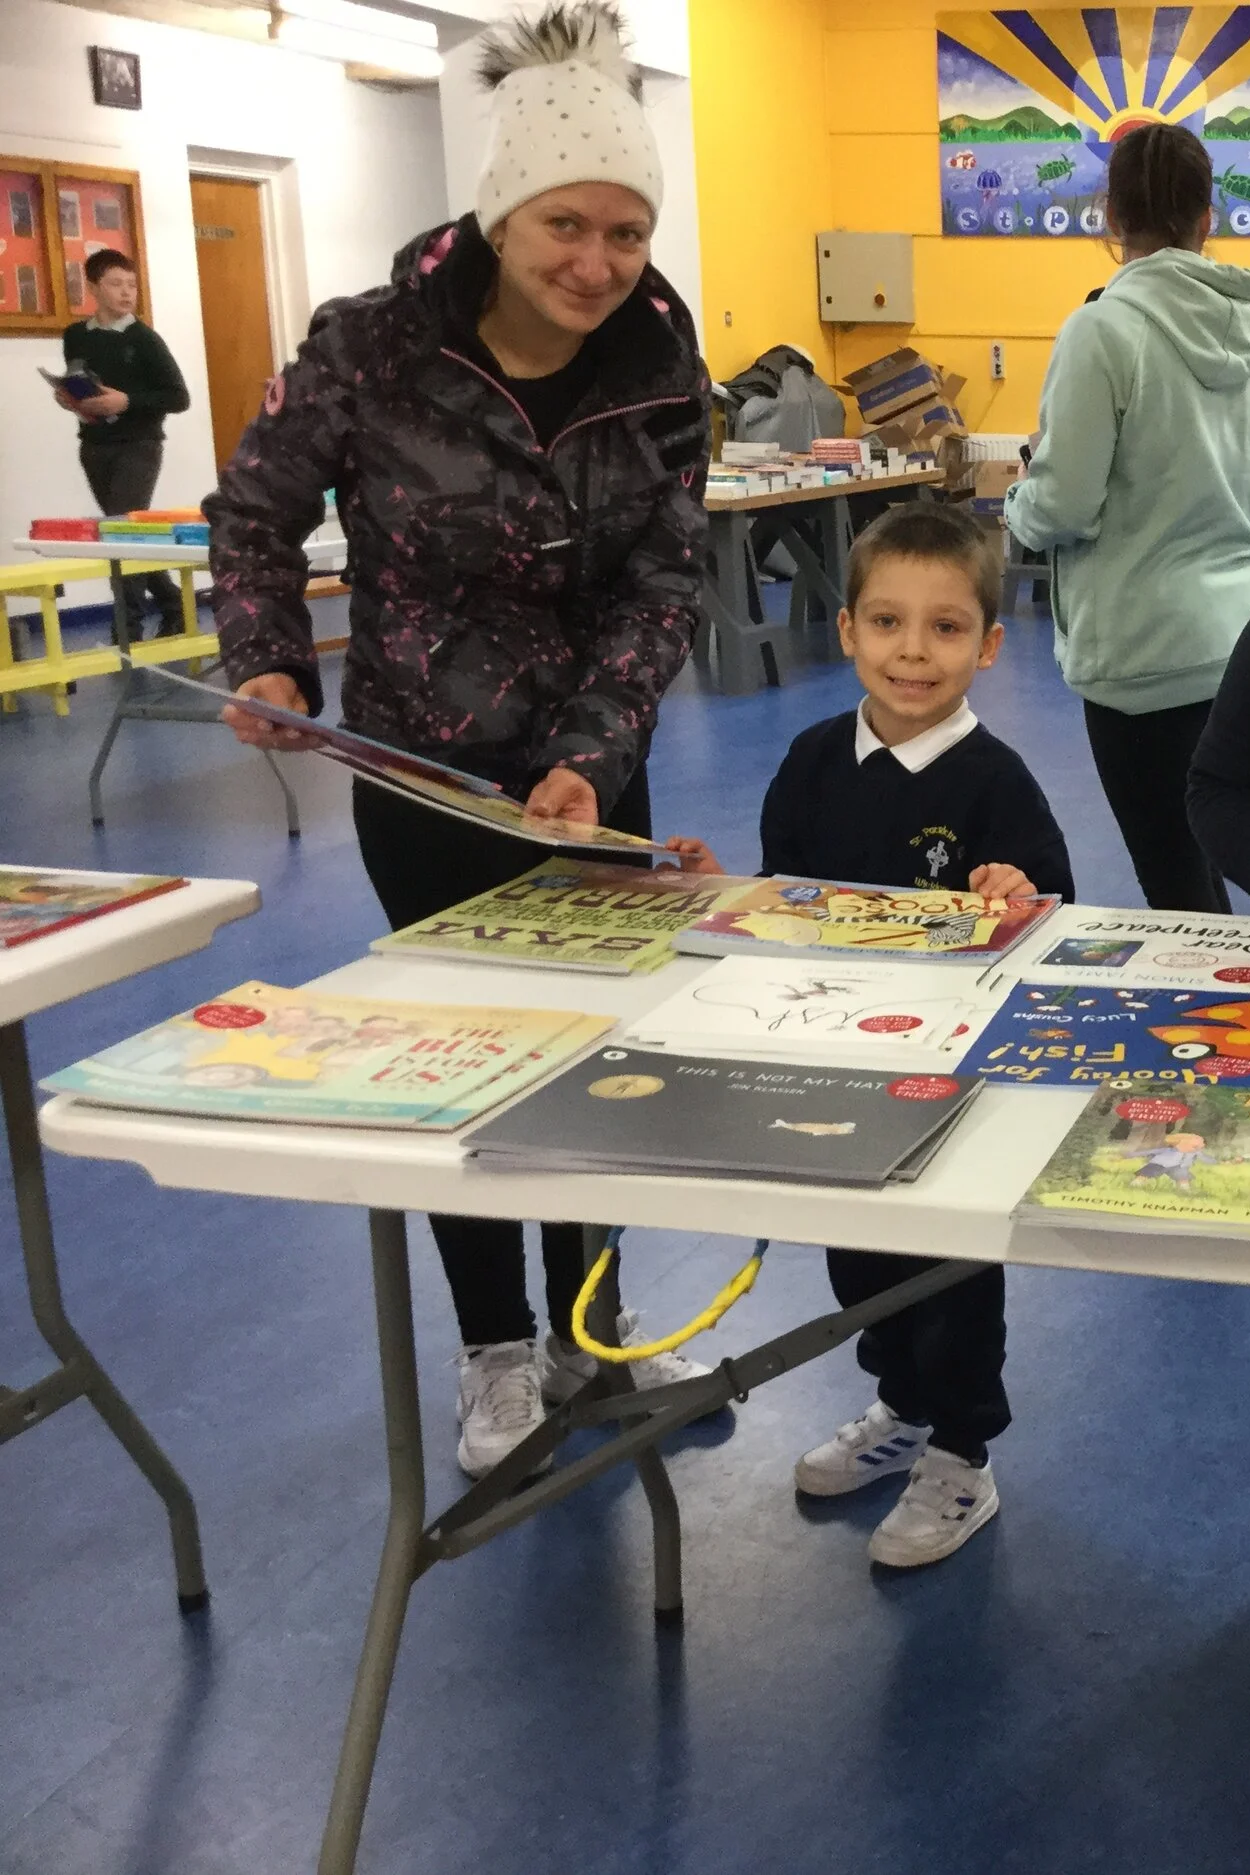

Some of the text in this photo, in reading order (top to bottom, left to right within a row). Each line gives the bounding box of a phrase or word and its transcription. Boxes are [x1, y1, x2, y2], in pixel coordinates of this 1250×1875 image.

[493, 883, 722, 914] WORLD
[836, 896, 992, 914] MOOSE
[416, 920, 655, 951] SAM
[848, 927, 930, 948] Z
[1132, 974, 1205, 985] SIMON
[1011, 1011, 1137, 1024] Lucy Cousins
[449, 1026, 507, 1041] THE
[408, 1038, 511, 1057] BUS
[986, 1042, 1126, 1062] Fish!
[424, 1055, 488, 1070] FOR
[676, 1065, 888, 1091] THIS IS NOT MY HAT
[976, 1065, 1219, 1086] Hooray for
[726, 1082, 807, 1096] JON KLASSEN
[1060, 1195, 1136, 1209] TIMOTHY
[1143, 1203, 1230, 1216] KNAPMAN
